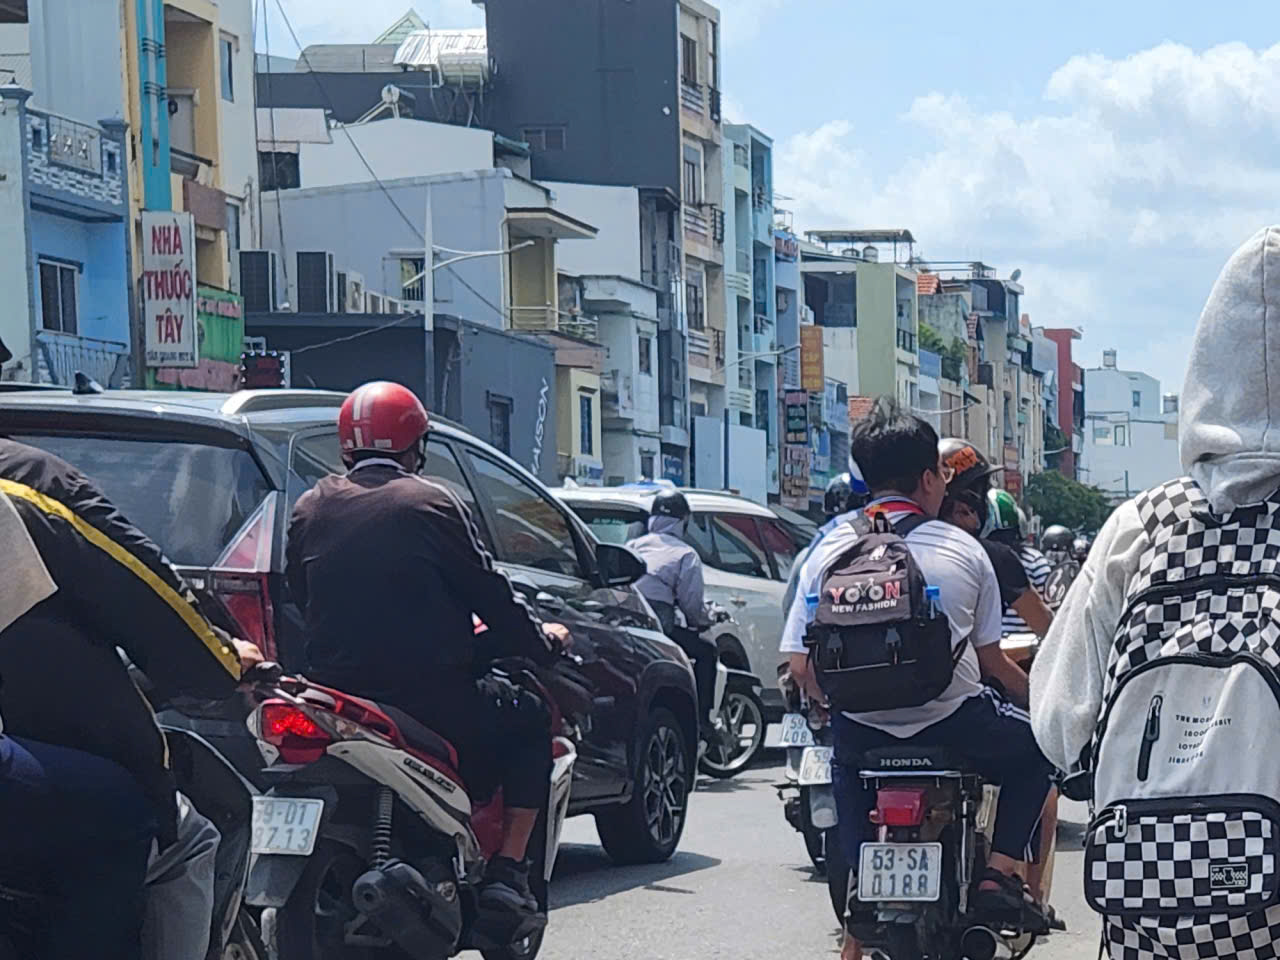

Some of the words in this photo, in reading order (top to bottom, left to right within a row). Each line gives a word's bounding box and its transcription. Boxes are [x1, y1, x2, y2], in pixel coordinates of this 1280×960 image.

[152, 218, 184, 255] NHÀ
[144, 259, 192, 300] THUỐC
[156, 308, 184, 344] TÂY
[831, 604, 854, 613] NEW
[856, 599, 897, 612] FASHION
[880, 758, 932, 767] HONDA
